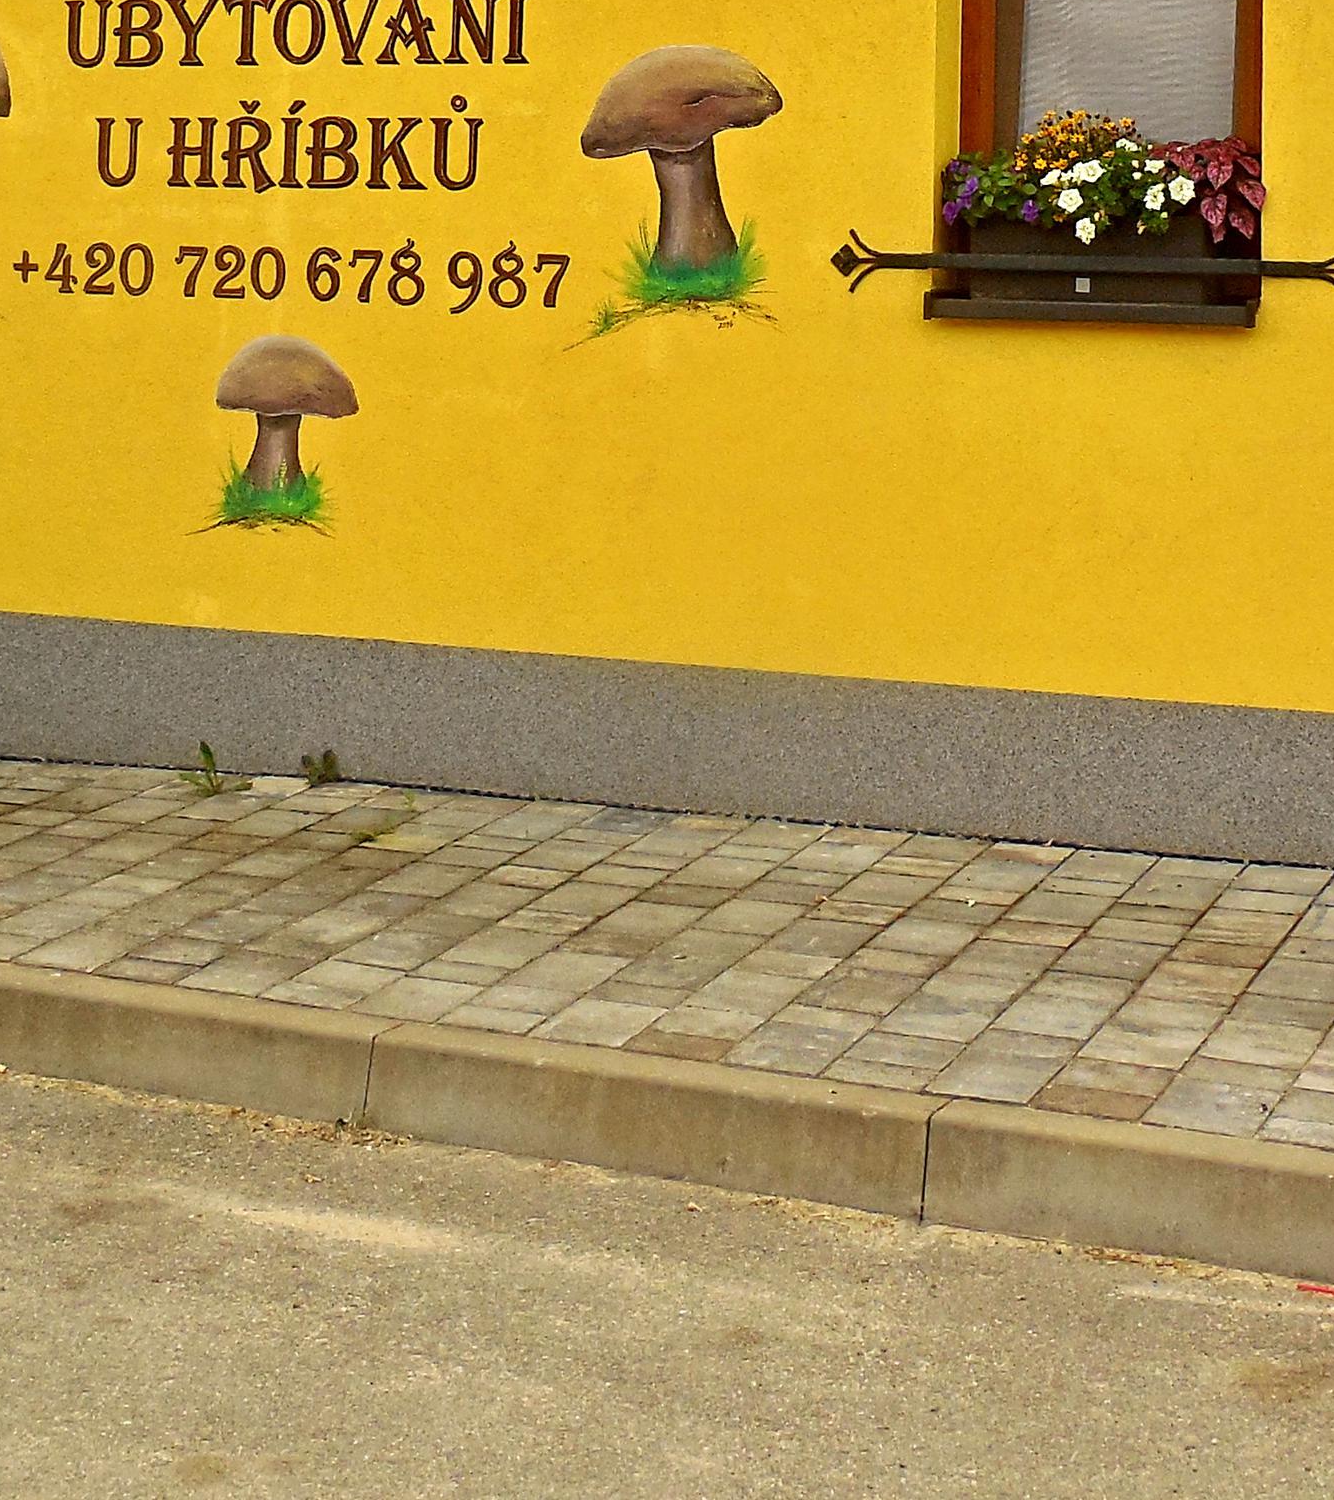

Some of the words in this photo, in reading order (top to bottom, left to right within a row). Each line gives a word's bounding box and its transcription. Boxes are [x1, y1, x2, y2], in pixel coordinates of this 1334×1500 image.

[95, 117, 143, 187] U
[167, 94, 484, 194] HŘÍBKŮ
[12, 242, 154, 296] +420
[174, 244, 286, 301] 720
[306, 237, 425, 306] 678
[447, 240, 571, 315] 987
